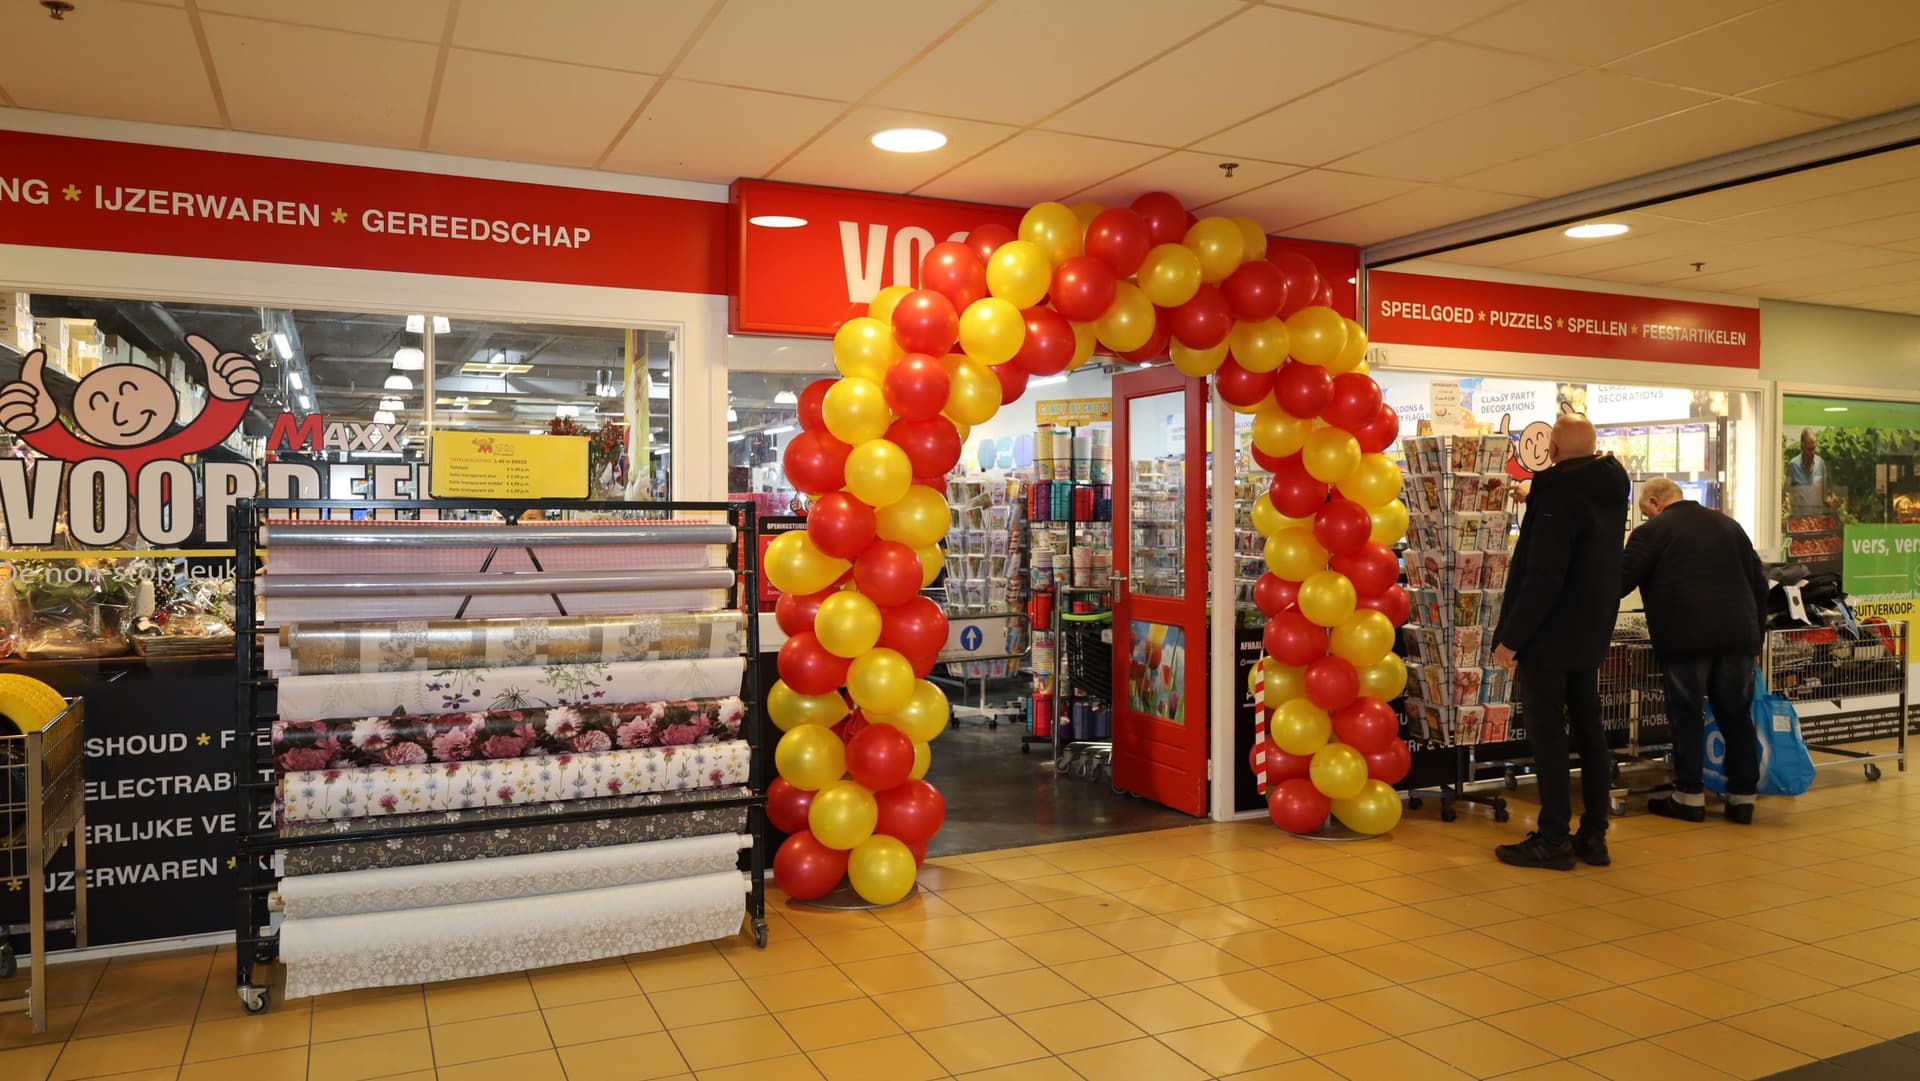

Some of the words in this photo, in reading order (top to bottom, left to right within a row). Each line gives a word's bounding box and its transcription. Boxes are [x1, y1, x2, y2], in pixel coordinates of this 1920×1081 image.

[95, 184, 320, 228] IJZERWAREN
[361, 208, 592, 249] GEREEDSCHAP
[838, 220, 970, 304] VO
[1380, 299, 1474, 325] SPEELGOED
[1489, 310, 1553, 332] PUZZELS
[1567, 317, 1628, 338] SPELLEN
[1642, 323, 1747, 347] FEESTARTIKELEN
[1394, 404, 1418, 414] LOONS
[1480, 401, 1536, 415] DECORATIONS
[1481, 392, 1510, 404] CLASSY
[1510, 390, 1537, 401] PARTY
[1598, 390, 1664, 404] DECORATIONS
[1852, 538, 1889, 557] vers,
[1894, 537, 1920, 553] ver
[45, 559, 176, 587] non-stop
[84, 732, 188, 758] SHOUD
[63, 816, 193, 847] ERLIJKE
[44, 856, 218, 894] JZERWAREN
